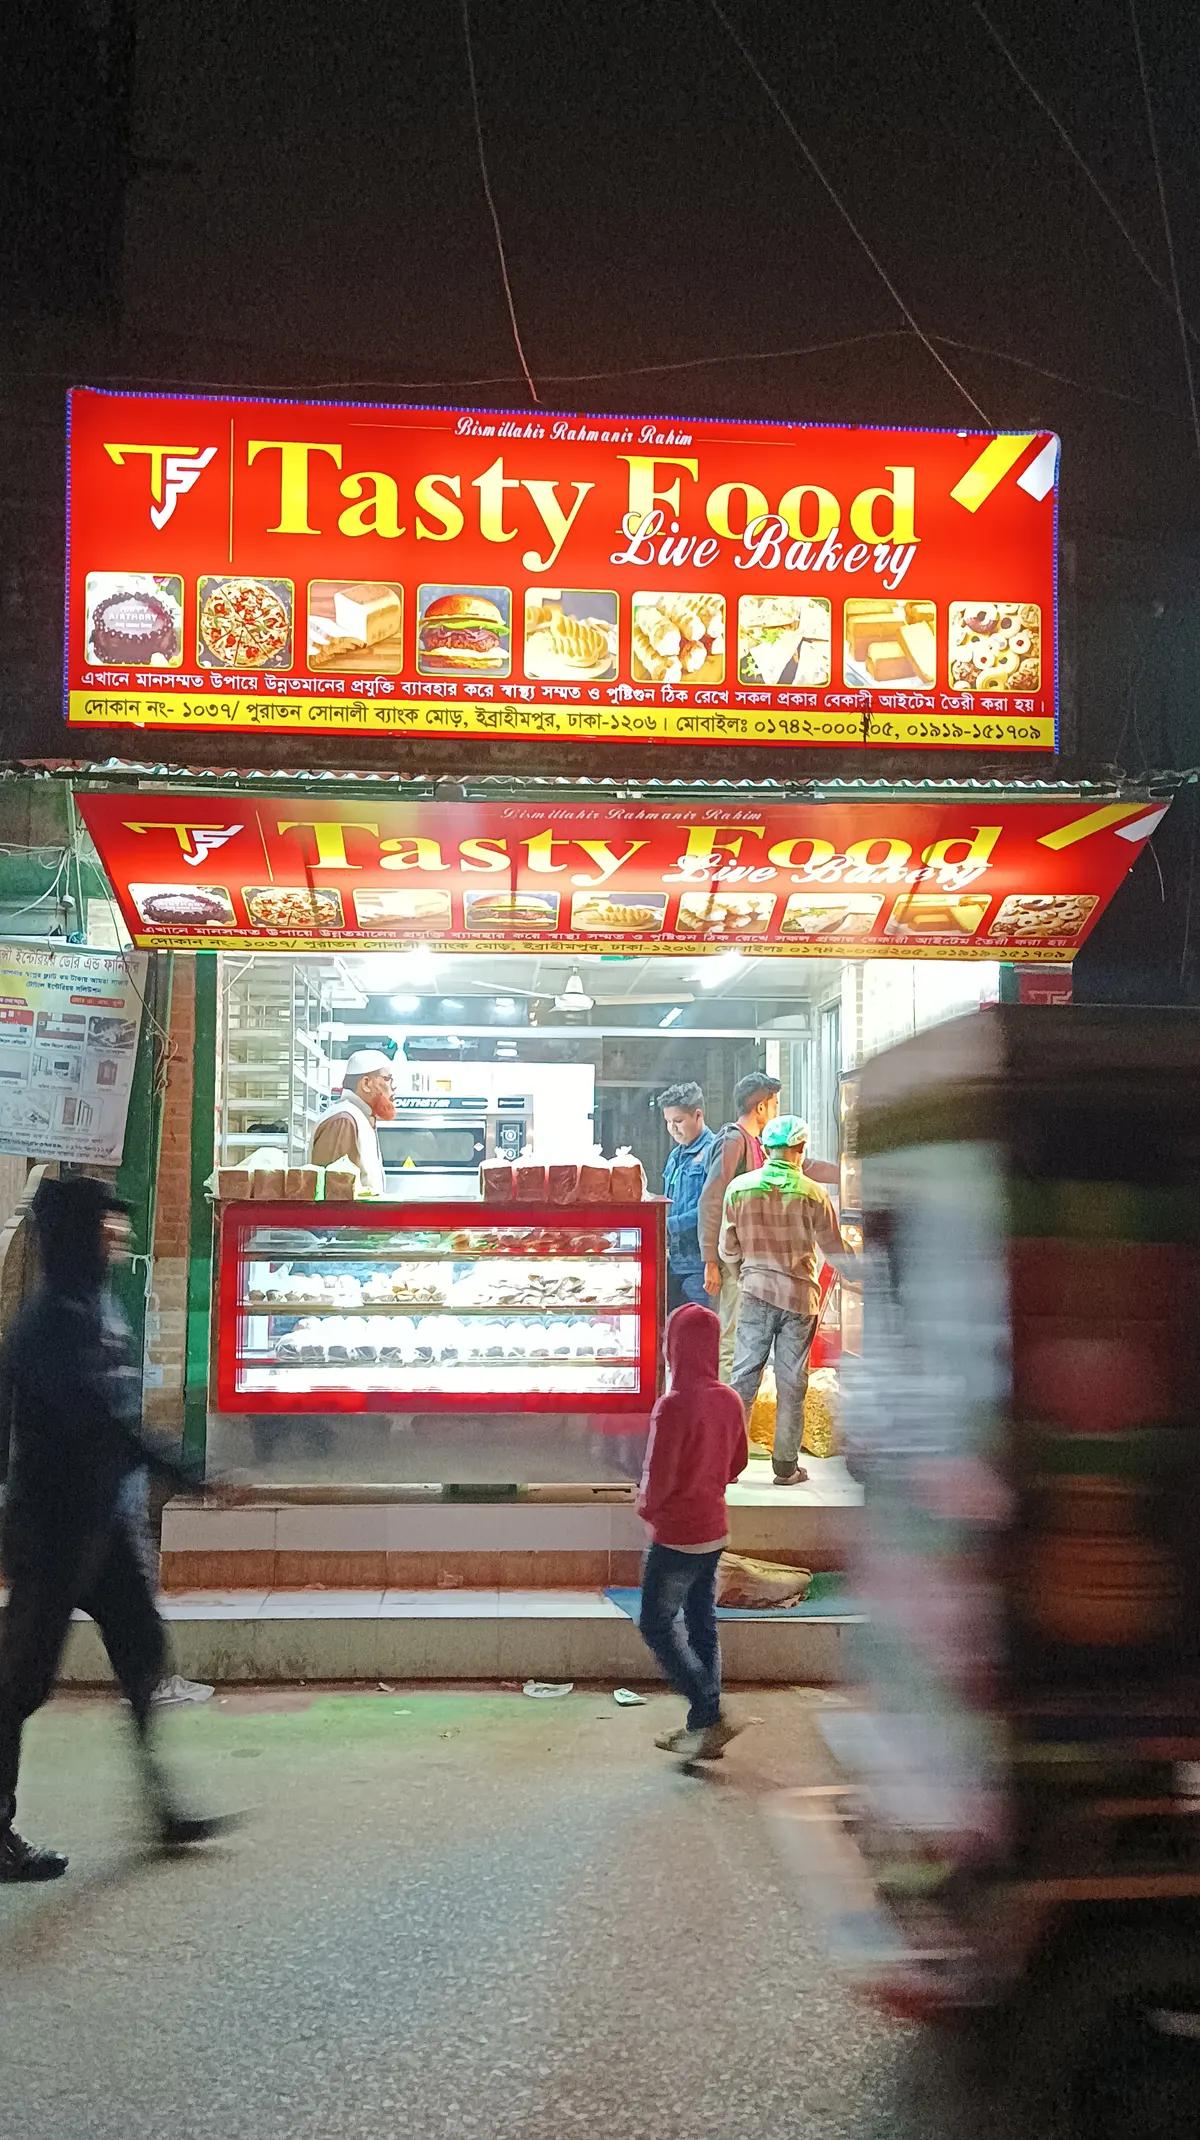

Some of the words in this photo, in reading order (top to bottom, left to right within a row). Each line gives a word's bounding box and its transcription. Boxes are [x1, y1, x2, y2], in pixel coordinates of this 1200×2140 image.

[454, 416, 545, 439] Bismillahir
[549, 421, 633, 443] Rahmanir
[637, 425, 692, 446] Rahim
[248, 440, 595, 573] Tasty
[615, 455, 922, 545] Food
[610, 510, 720, 567] Live
[734, 514, 917, 590] Bakery
[81, 671, 129, 687] এখানে
[136, 673, 204, 689] মানসম্মত
[210, 671, 258, 690] উপায়ে
[264, 673, 345, 694] উন্নতমানের
[350, 675, 395, 697] প্রযুক্তি
[401, 681, 458, 696] ব্যাবহার
[463, 683, 494, 697] করে
[541, 685, 580, 700] সম্মত
[588, 687, 600, 700] ও
[660, 684, 688, 703] ঠিক
[694, 690, 729, 704] রেখে
[735, 691, 771, 705] সকল
[777, 692, 817, 706] প্রকার
[824, 689, 873, 708] বেকারী
[878, 693, 935, 709] আইটেম
[940, 692, 974, 711] তৈরী
[981, 697, 1008, 711] করা
[1014, 697, 1034, 712] হয়
[84, 698, 141, 716] দোকান
[246, 703, 302, 722] পুরাতন
[308, 701, 369, 722] সোনালী
[374, 708, 420, 724] ব্যাংক
[474, 705, 560, 731] ইব্রাহীমপুর,
[907, 722, 1041, 740] ০১৯১৯-১৫১৭০৯
[604, 808, 697, 821] Rahmanir
[702, 808, 762, 821] Rahim
[277, 821, 651, 886] Tasty
[669, 826, 1003, 869] Food
[662, 854, 778, 883] Live
[790, 854, 987, 892] Bakery
[151, 937, 203, 946] দোকান
